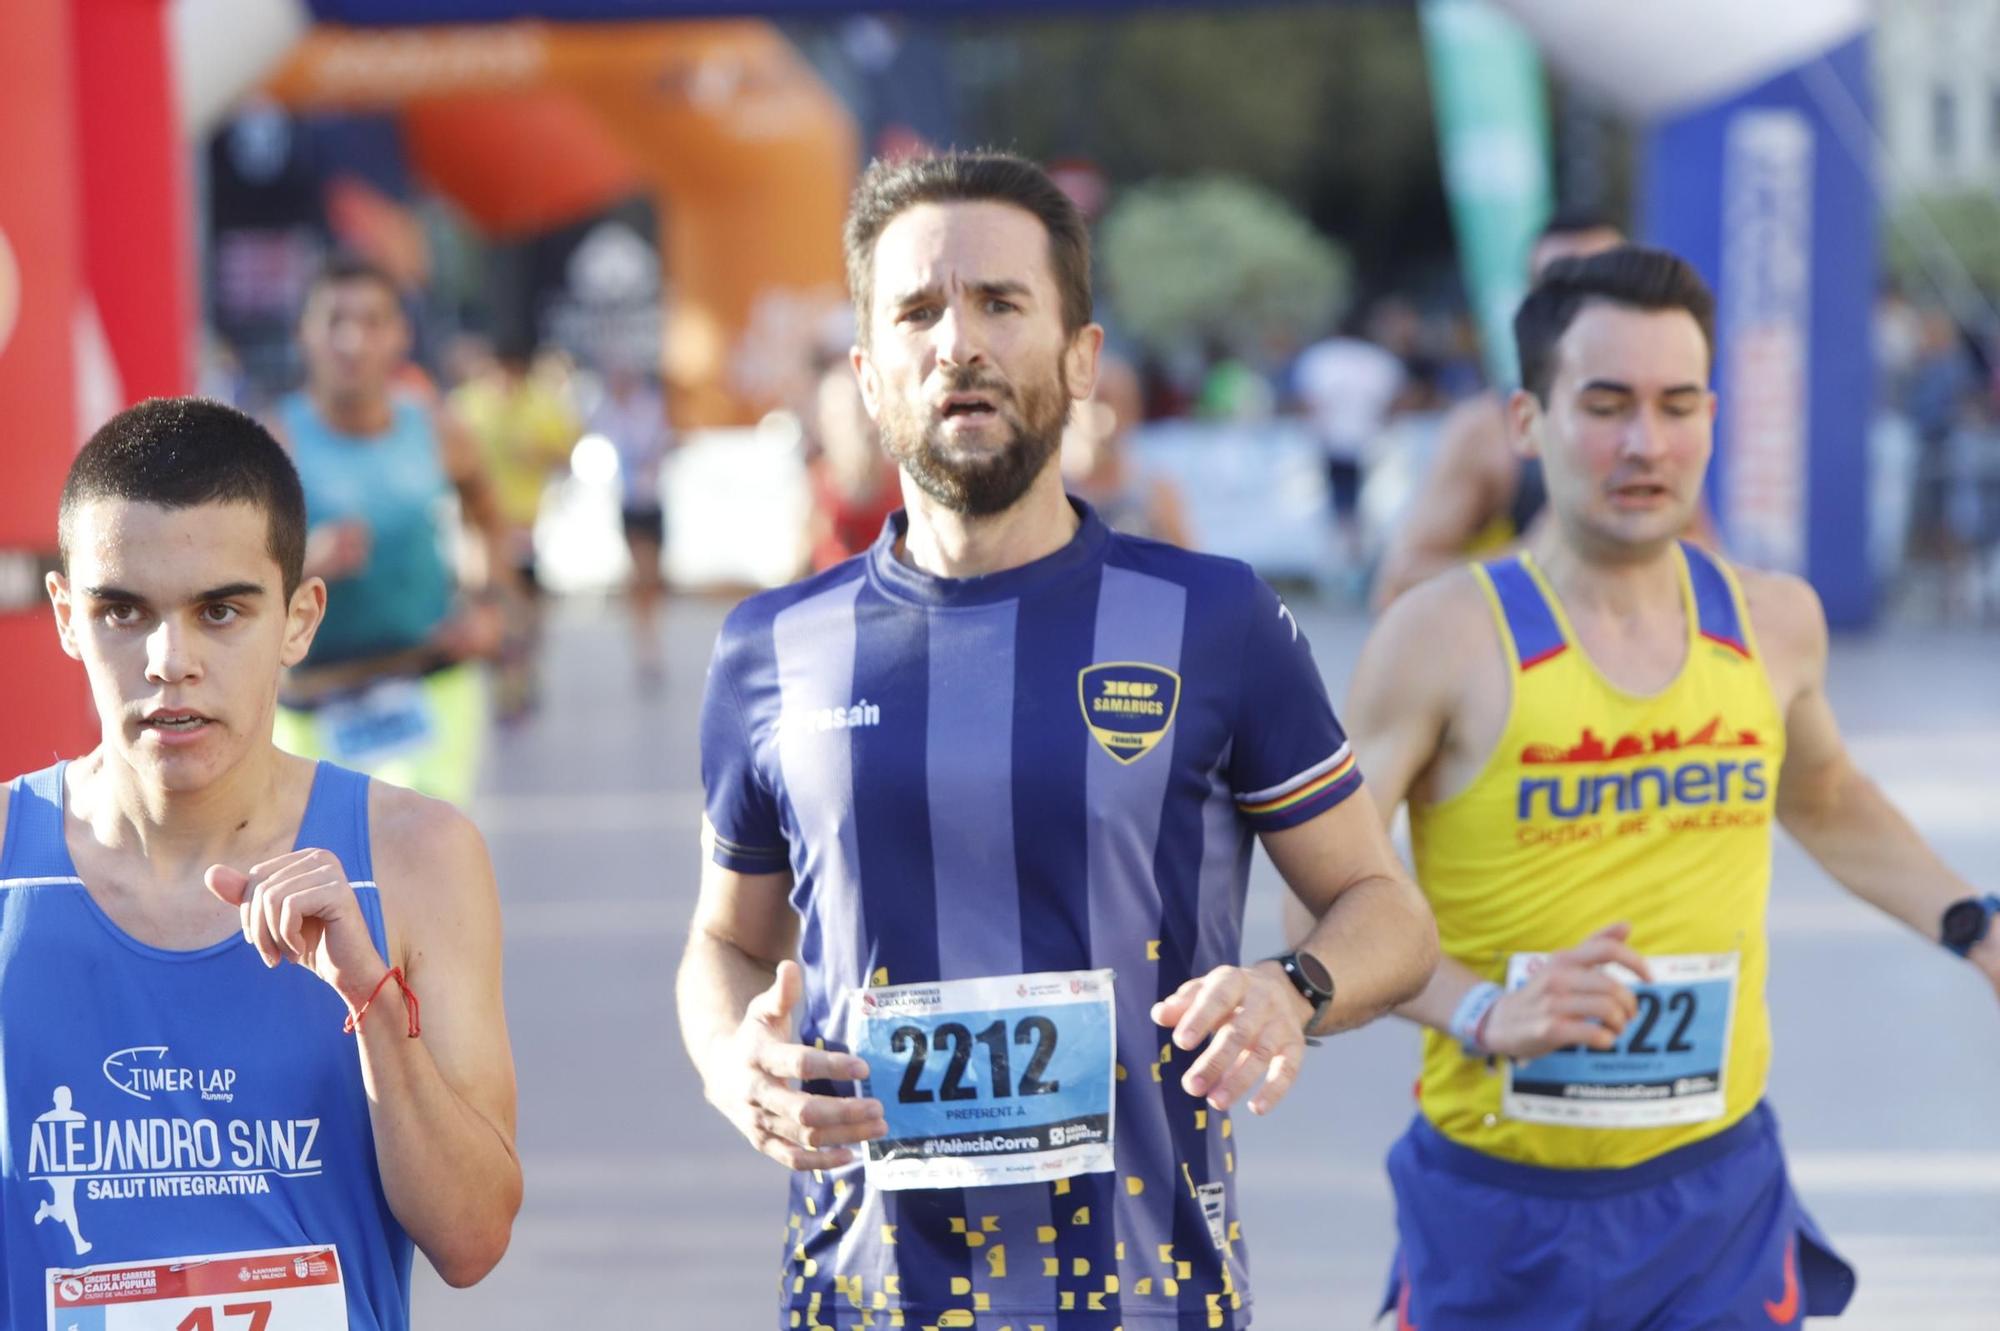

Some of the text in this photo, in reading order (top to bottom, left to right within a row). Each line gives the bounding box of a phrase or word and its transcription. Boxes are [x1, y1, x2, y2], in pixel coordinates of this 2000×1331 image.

[1093, 697, 1164, 716] SAMARUCS
[1516, 760, 1766, 821] runners
[890, 1015, 1059, 1105] 2212
[129, 1068, 236, 1092] TIMER LAP
[200, 1090, 234, 1103] Running
[946, 1106, 1026, 1121] PREFERENT A
[28, 1117, 322, 1173] ALEJANDRO SANZ
[924, 1134, 1039, 1155] #ValènciaCorre
[1065, 1129, 1103, 1144] popular
[87, 1174, 270, 1200] SALUT INTEGRATIVA
